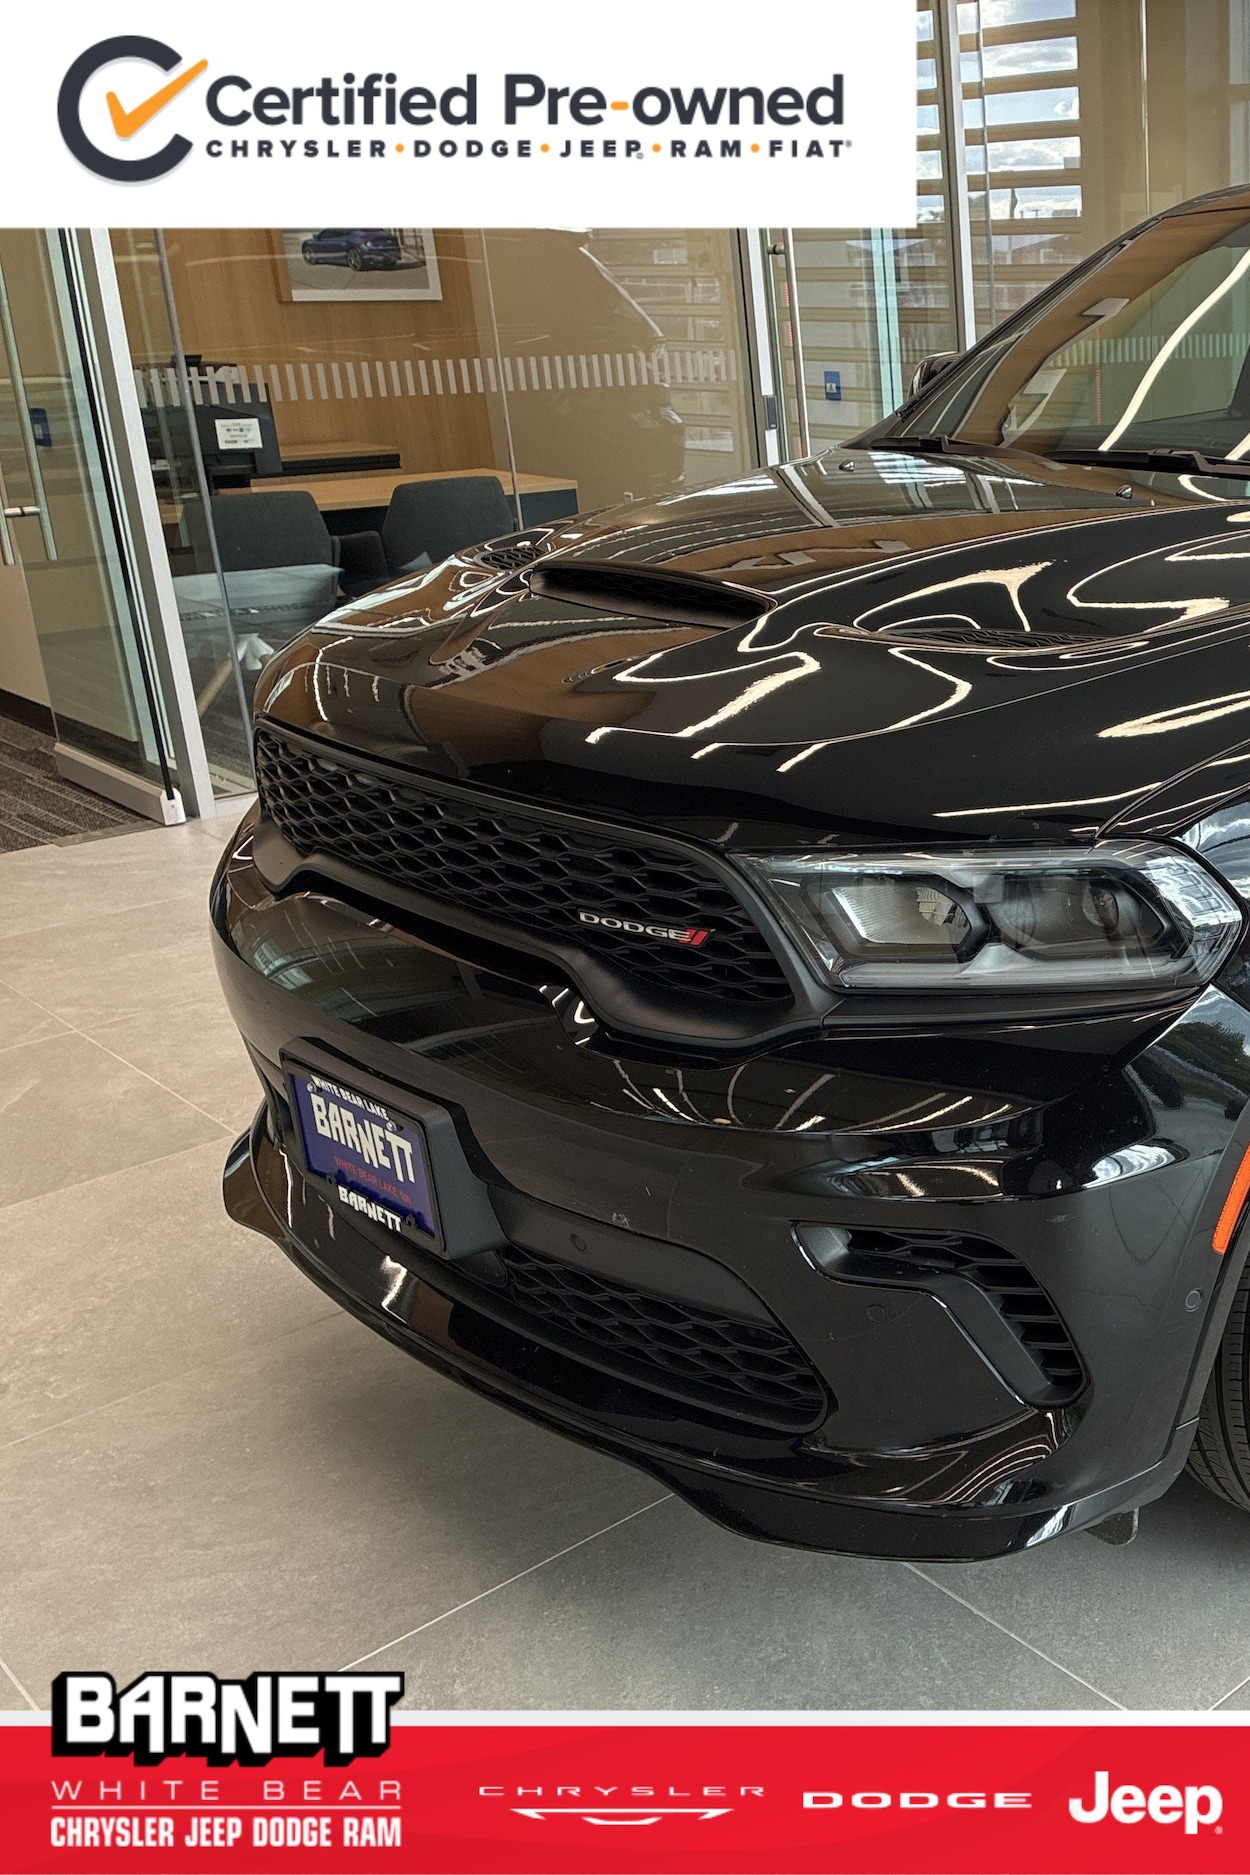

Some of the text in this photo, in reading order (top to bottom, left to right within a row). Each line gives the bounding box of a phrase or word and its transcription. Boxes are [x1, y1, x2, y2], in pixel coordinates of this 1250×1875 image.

[579, 911, 692, 942] DODGE
[310, 1074, 390, 1121] WHITE BEAR LAKE
[310, 1092, 416, 1185] BARNETT
[358, 1167, 379, 1187] BEAR
[337, 1184, 402, 1233] BARNETT
